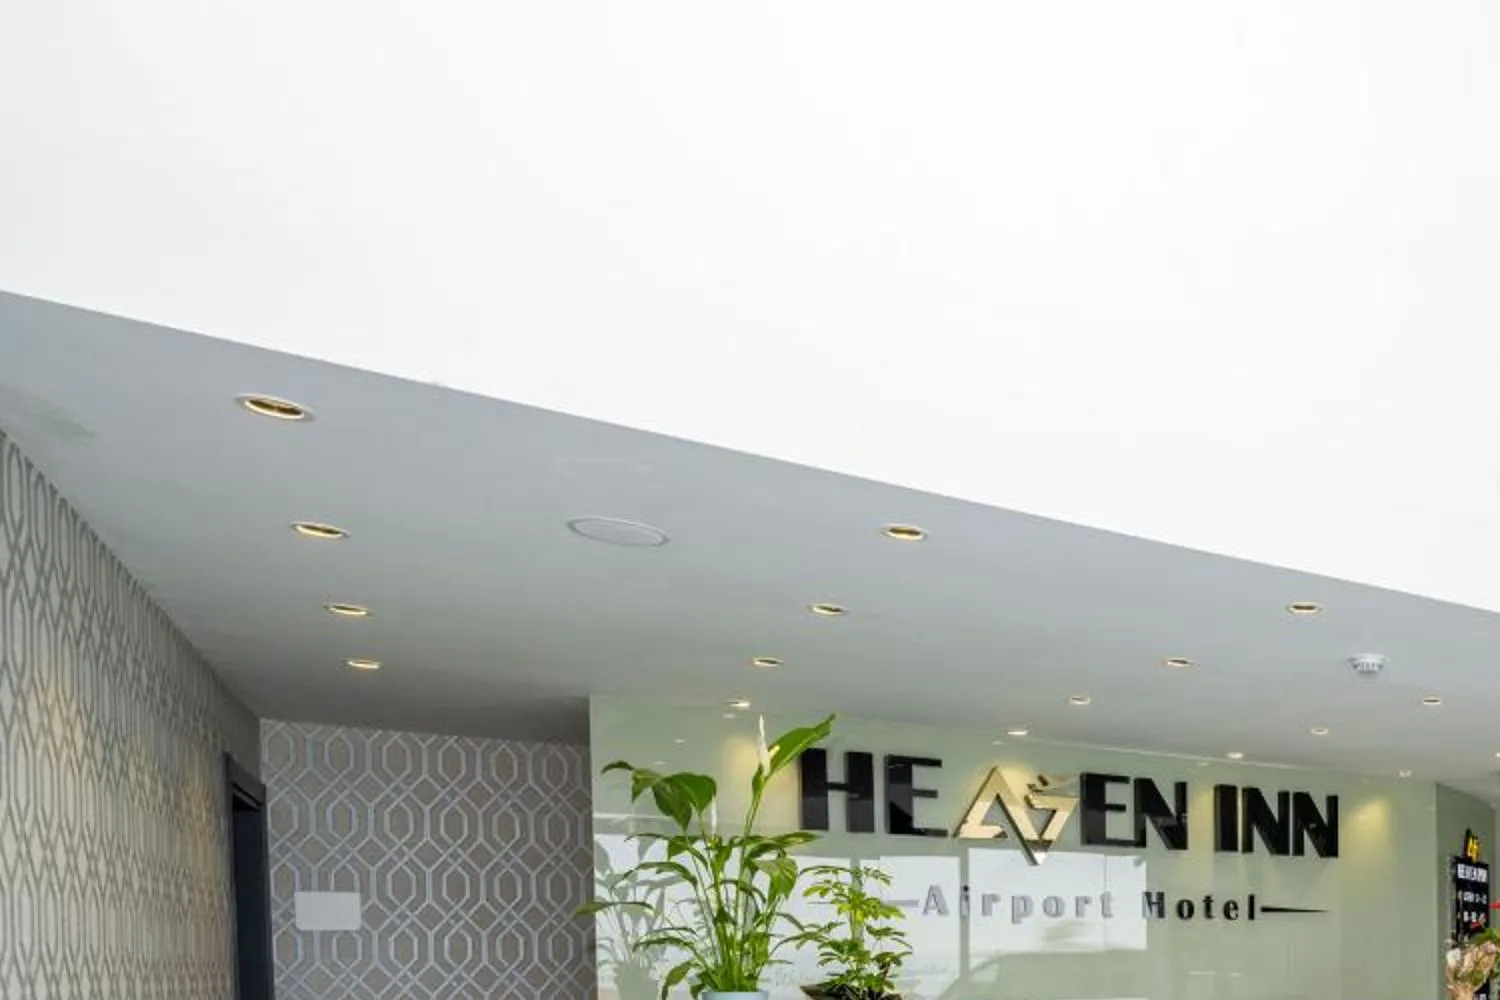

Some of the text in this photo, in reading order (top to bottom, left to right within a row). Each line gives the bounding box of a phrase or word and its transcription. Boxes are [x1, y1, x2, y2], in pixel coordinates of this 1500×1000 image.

[1213, 783, 1340, 858] INN
[921, 882, 1257, 924] Airport Hotel
